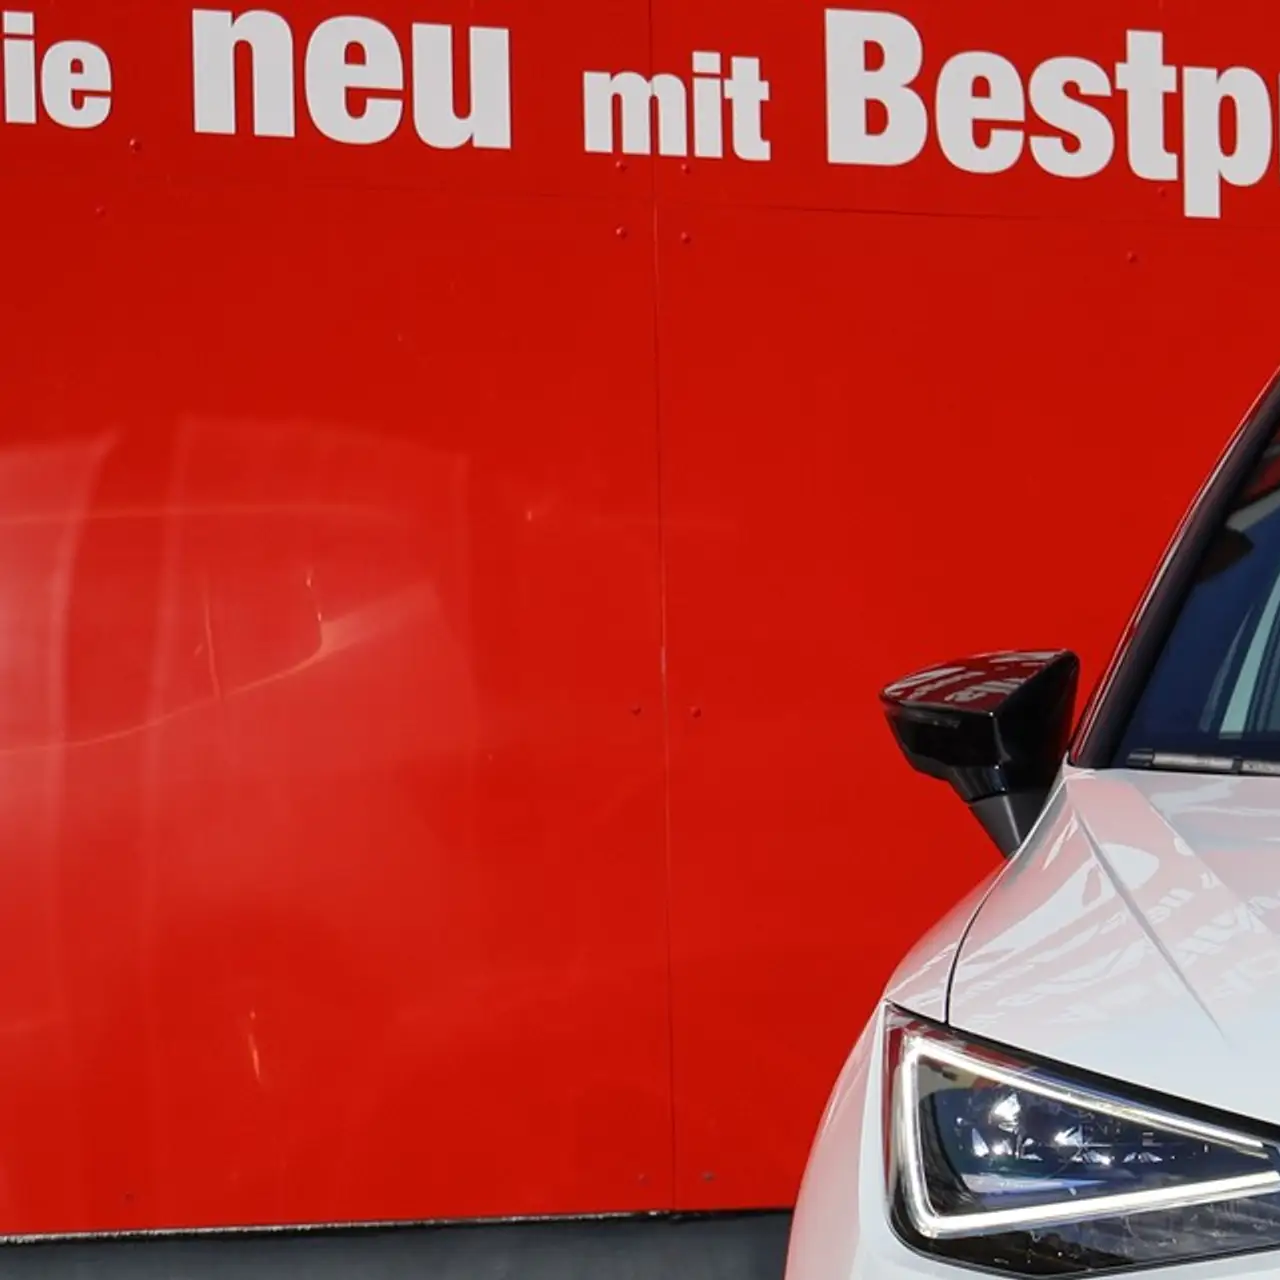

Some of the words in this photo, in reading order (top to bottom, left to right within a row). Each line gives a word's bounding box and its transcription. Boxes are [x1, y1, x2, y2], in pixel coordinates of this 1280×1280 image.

[3, 10, 112, 129] ie
[191, 8, 512, 150] neu
[583, 50, 771, 161] mit
